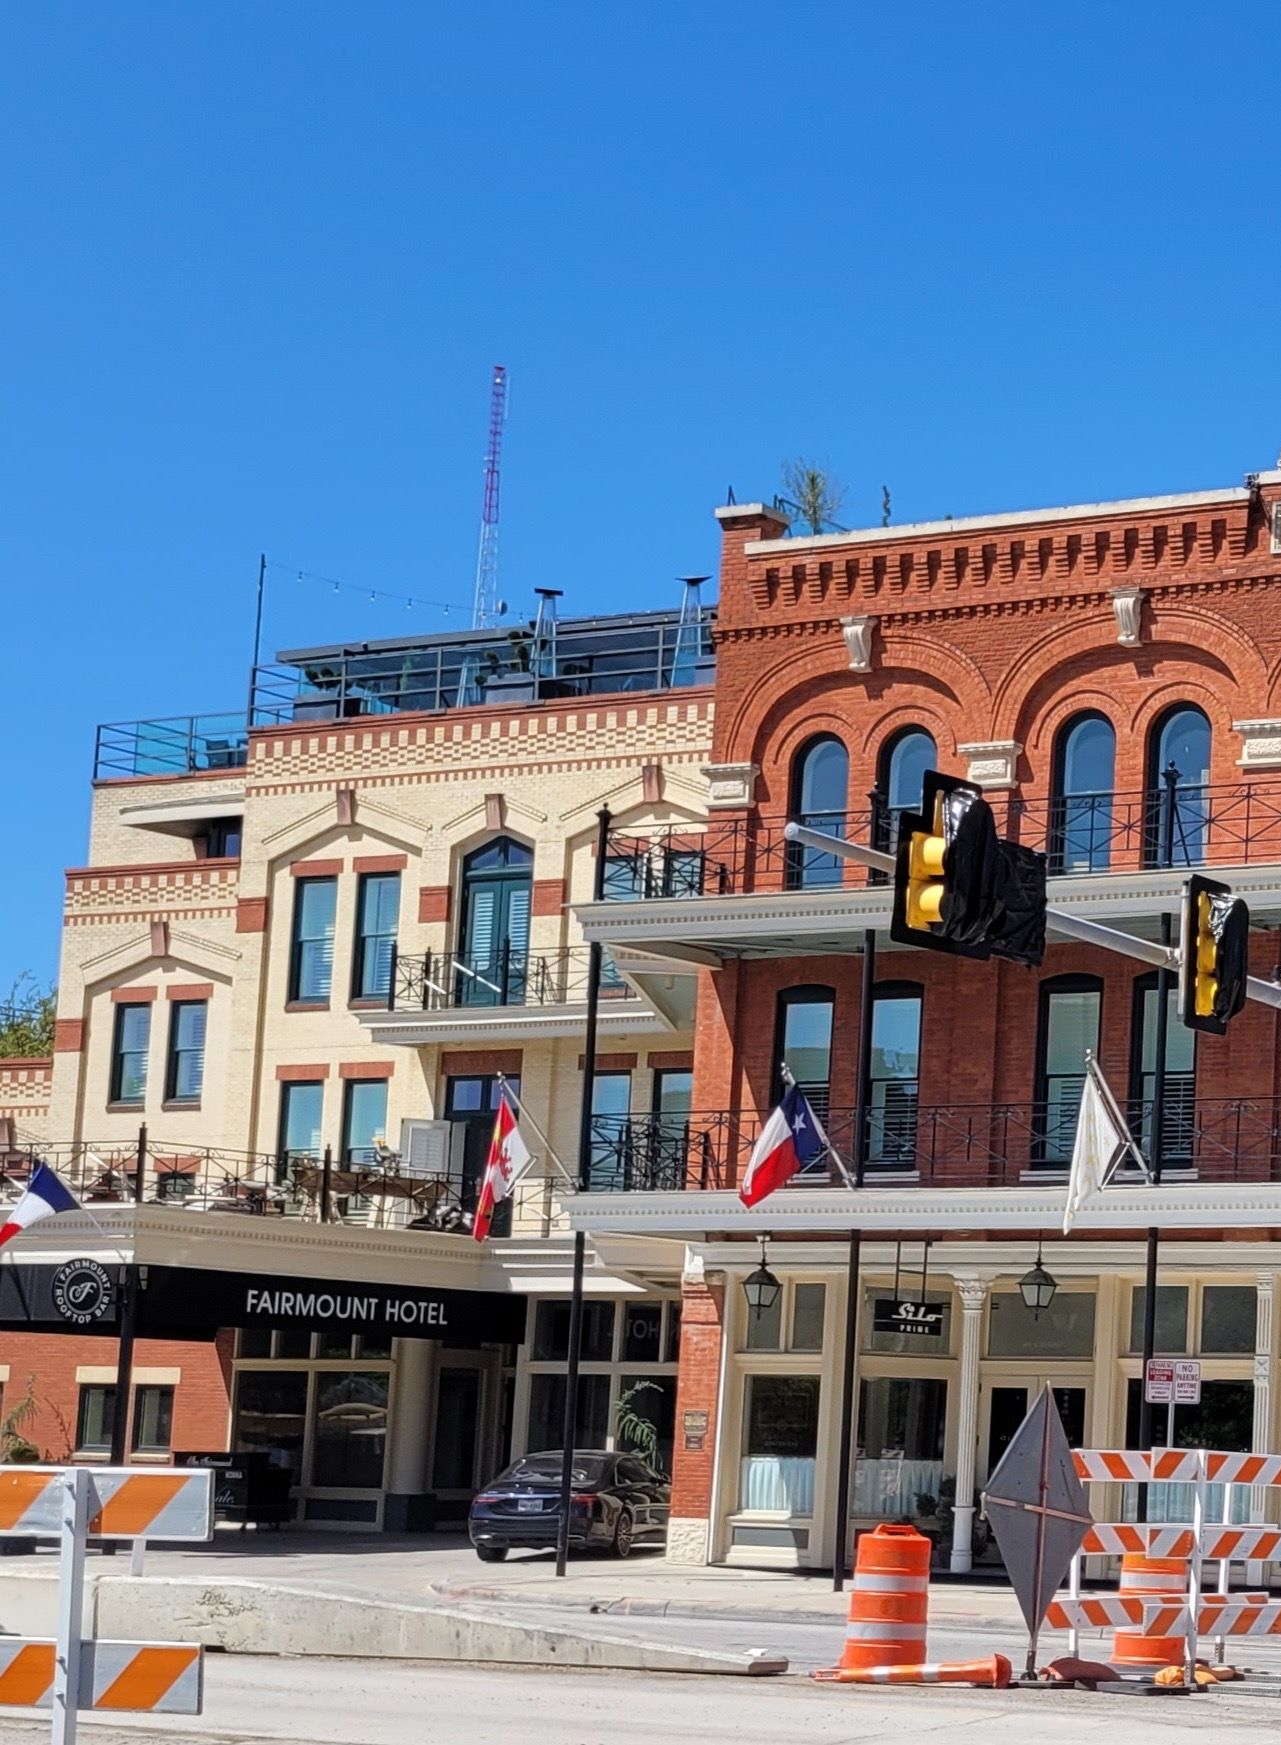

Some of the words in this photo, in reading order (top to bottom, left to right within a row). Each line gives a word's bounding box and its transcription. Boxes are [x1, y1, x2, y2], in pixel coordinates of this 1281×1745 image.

[60, 1260, 112, 1288] FAIRMOUNT
[56, 1289, 92, 1324] ROOFTOP
[95, 1296, 110, 1317] BAR
[246, 1290, 379, 1320] FAIRMOUNT
[385, 1299, 448, 1325] HOTEL
[891, 1302, 944, 1322] Silo
[900, 1324, 930, 1334] PRIME
[1182, 1365, 1193, 1373] NO
